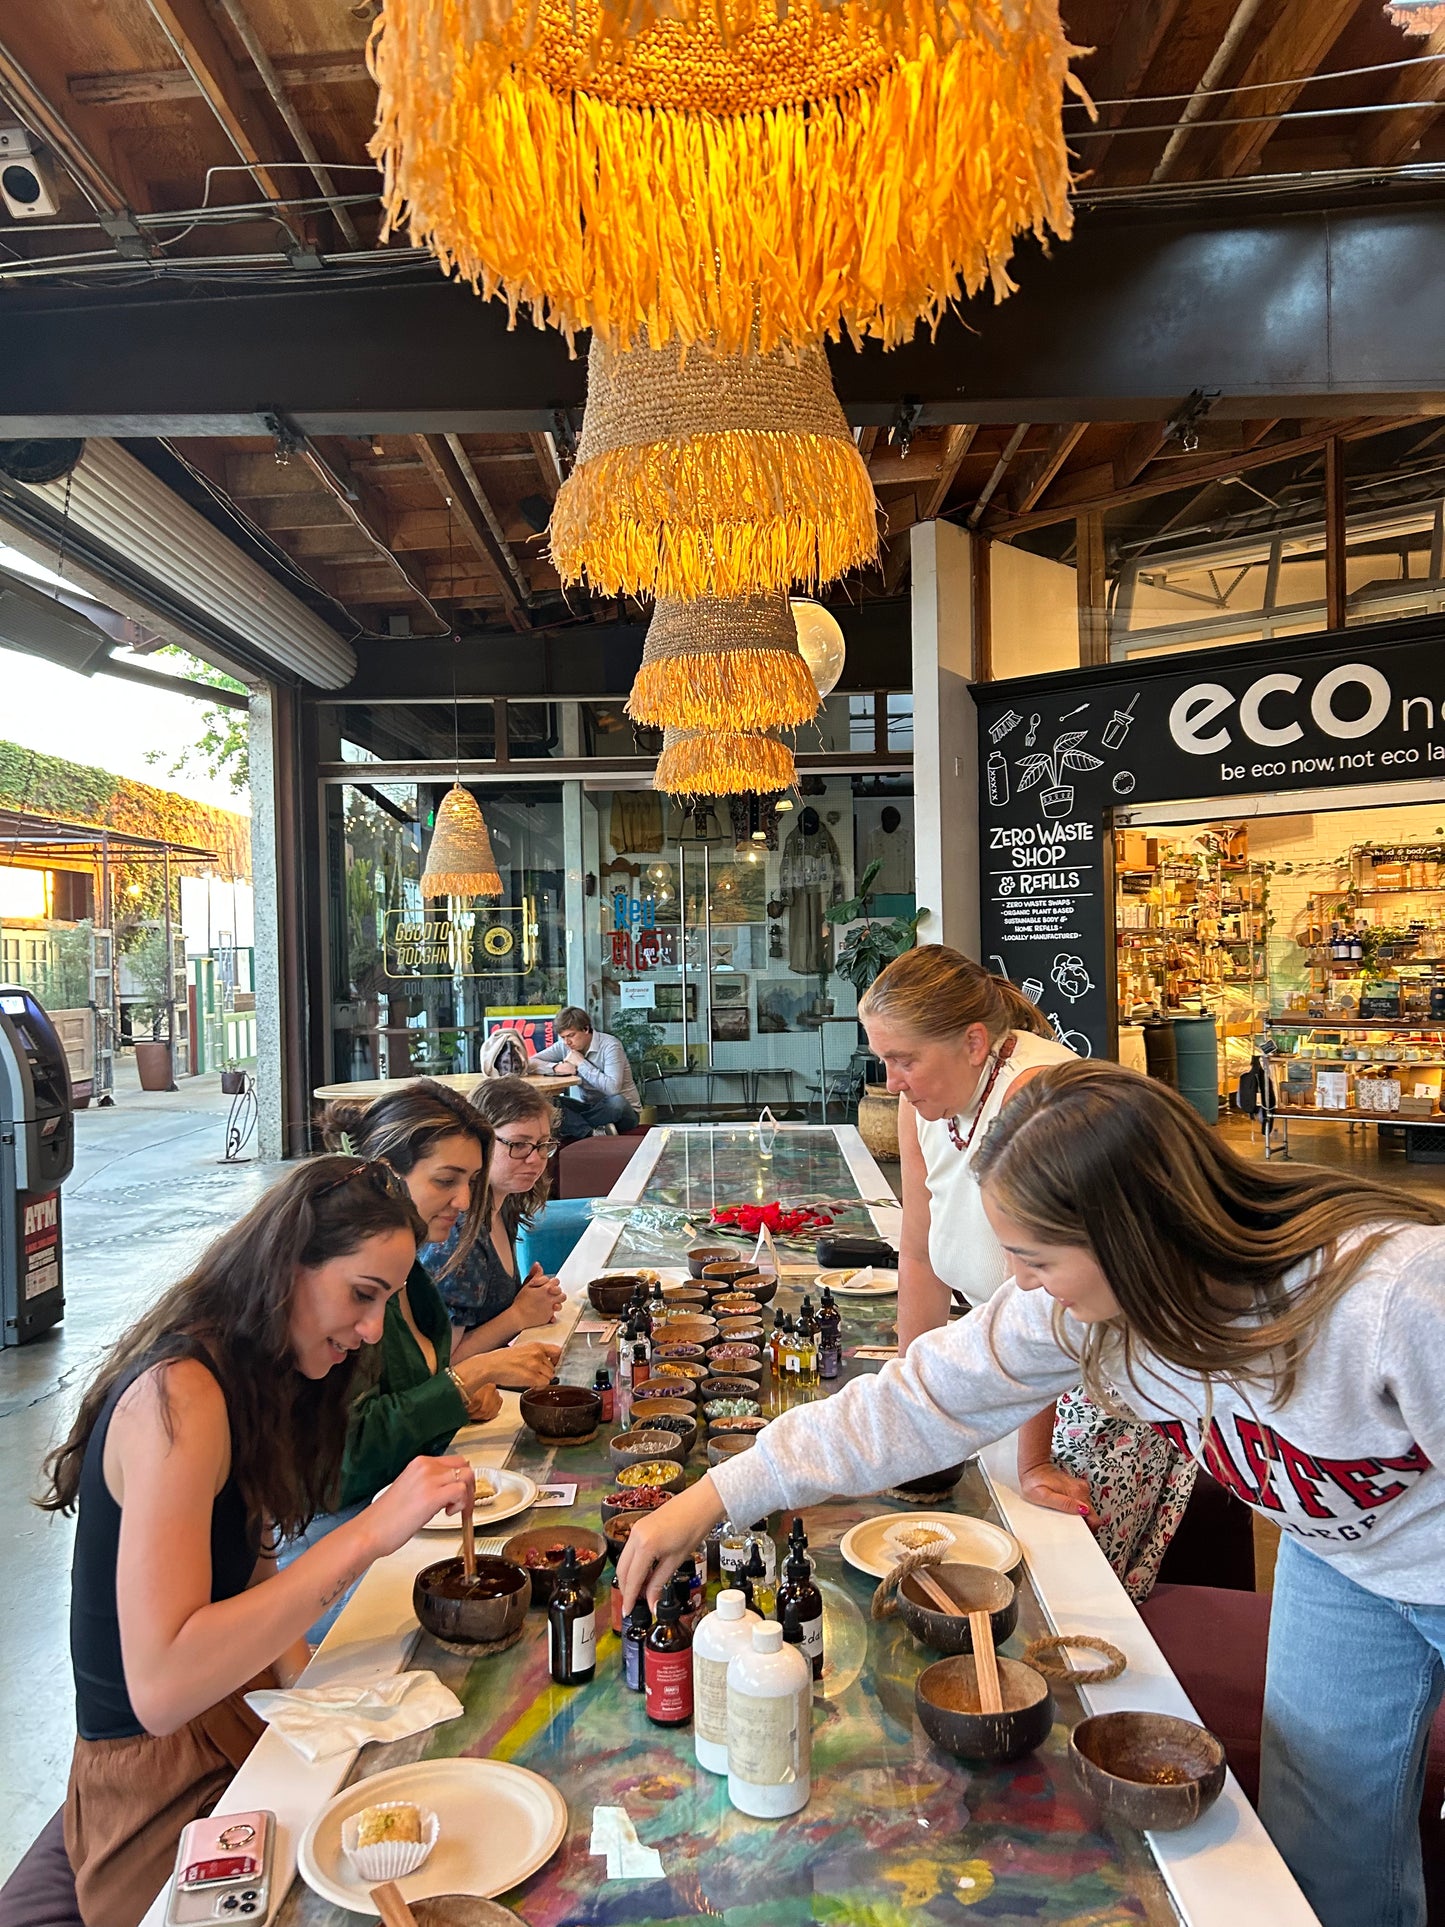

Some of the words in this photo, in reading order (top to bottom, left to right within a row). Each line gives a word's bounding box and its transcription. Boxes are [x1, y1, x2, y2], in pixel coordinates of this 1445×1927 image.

[1168, 663, 1391, 755] eco
[1402, 696, 1445, 732] n
[1221, 763, 1246, 781] be
[1251, 760, 1286, 778] eco
[1291, 756, 1335, 774] now,
[1339, 750, 1375, 769] not
[1381, 748, 1419, 766] eco
[989, 827, 1036, 849] ZERO
[1036, 820, 1094, 845] WASTE
[1011, 845, 1066, 868] SHOP
[998, 876, 1016, 896] &
[1048, 899, 1071, 907] SWAPS
[1034, 924, 1059, 932] REFILLS
[396, 945, 474, 965] DOUGHNS
[544, 1021, 554, 1048] POWE
[25, 1197, 57, 1236] ATM
